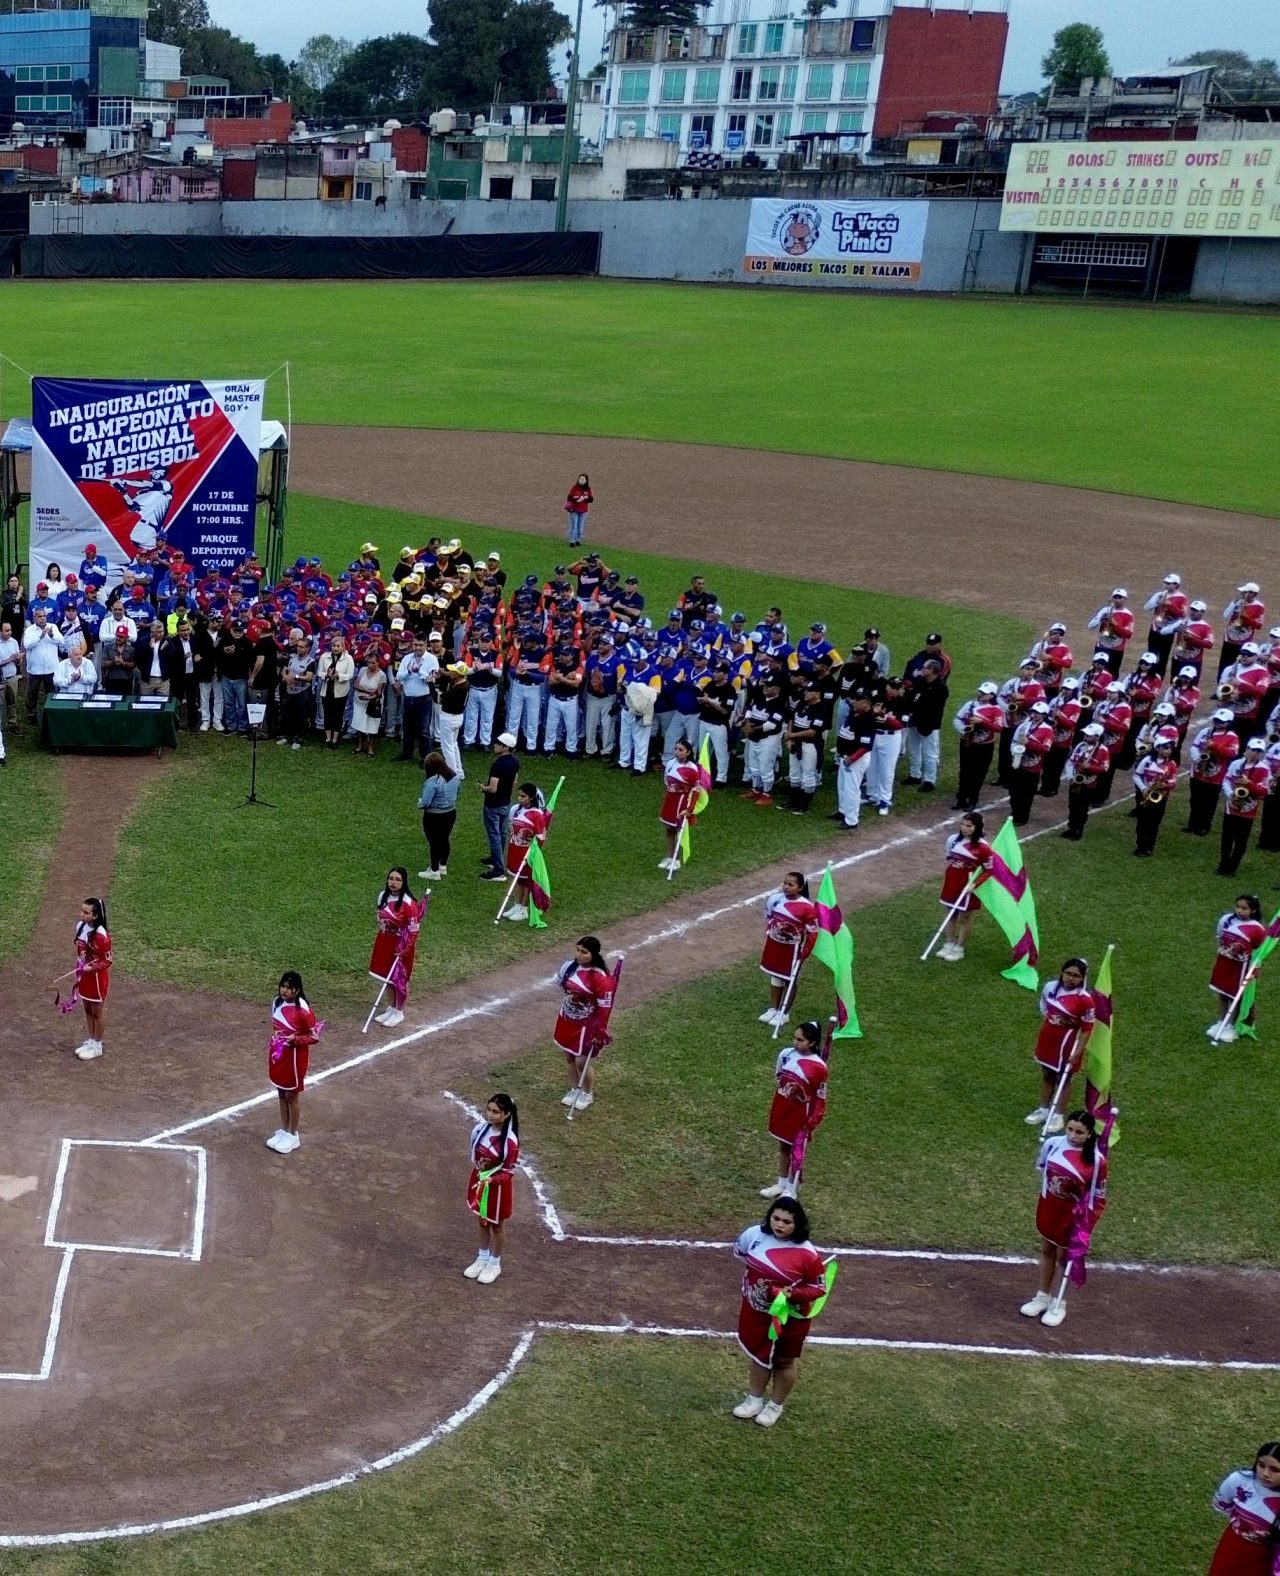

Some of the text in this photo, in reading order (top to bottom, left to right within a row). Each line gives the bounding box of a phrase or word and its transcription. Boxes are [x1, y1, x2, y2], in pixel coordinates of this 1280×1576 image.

[1067, 154, 1104, 166] BOLAS
[1126, 153, 1164, 167] STRIKES
[1185, 153, 1219, 167] OUTS
[1046, 178, 1051, 188] 1
[1058, 178, 1065, 188] 2
[1071, 178, 1079, 188] 3
[1084, 178, 1092, 188] 4
[1099, 178, 1106, 188] 5
[1112, 178, 1120, 188] 6
[1129, 178, 1135, 188] 7
[1141, 178, 1148, 188] 8
[1168, 178, 1178, 188] 10
[1199, 178, 1206, 188] C
[1230, 178, 1239, 188] H
[1256, 178, 1263, 188] E
[1006, 191, 1040, 204] VISITA
[832, 212, 899, 233] La Vaca
[839, 230, 892, 253] Pinta
[751, 260, 910, 277] LOS MEJORES TACOS DE XALAPA
[224, 385, 250, 393] GRAN
[224, 394, 261, 403] MASTER
[49, 384, 191, 428] INAUGURACIÓN
[69, 398, 216, 444] CAMPEONATO
[86, 423, 195, 462] NACIONAL
[80, 442, 200, 480] DE BEISBOL
[208, 491, 234, 499] 17 DE
[36, 507, 60, 515] SEDES
[192, 503, 249, 512] NOVIEMBRE
[196, 516, 244, 525] 17:00 HRS.
[200, 535, 238, 544] PARQUE
[191, 547, 246, 555] DEPORTIVO
